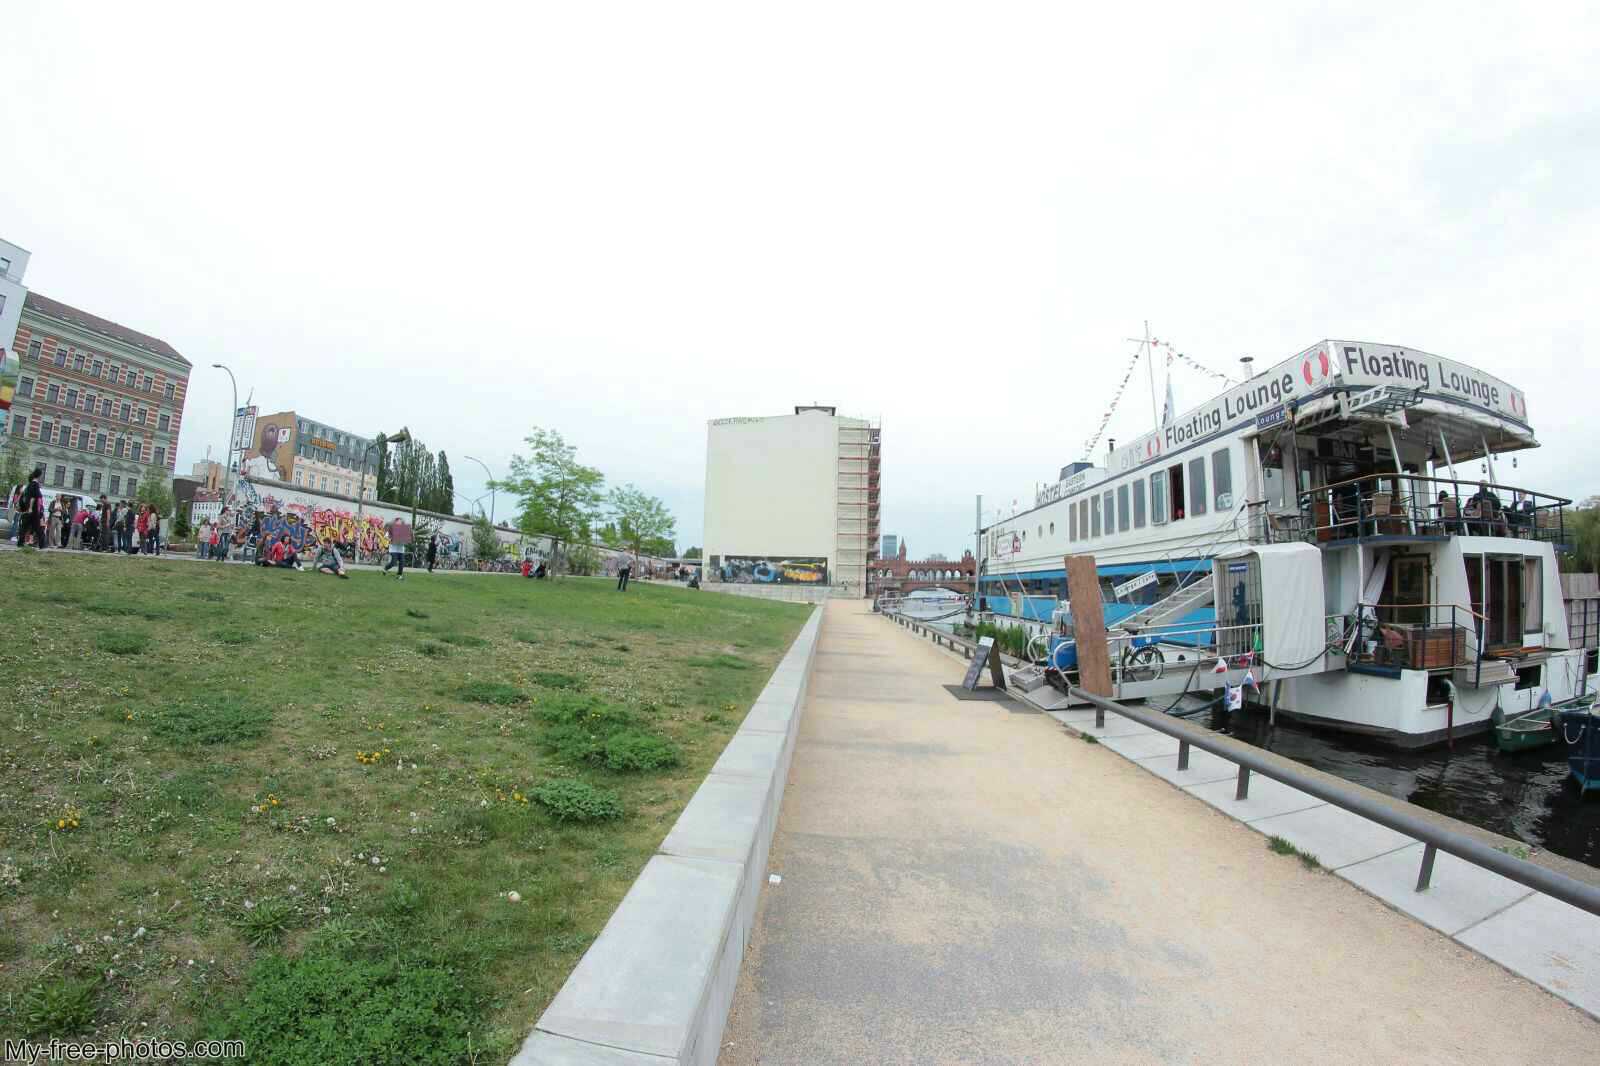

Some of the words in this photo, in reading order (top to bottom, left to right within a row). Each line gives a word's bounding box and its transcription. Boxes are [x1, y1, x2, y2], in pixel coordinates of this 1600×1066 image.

[1343, 346, 1430, 390] Floating
[1438, 361, 1500, 407] Lounge
[1164, 407, 1222, 449] Floating
[1224, 373, 1294, 421] Lounge
